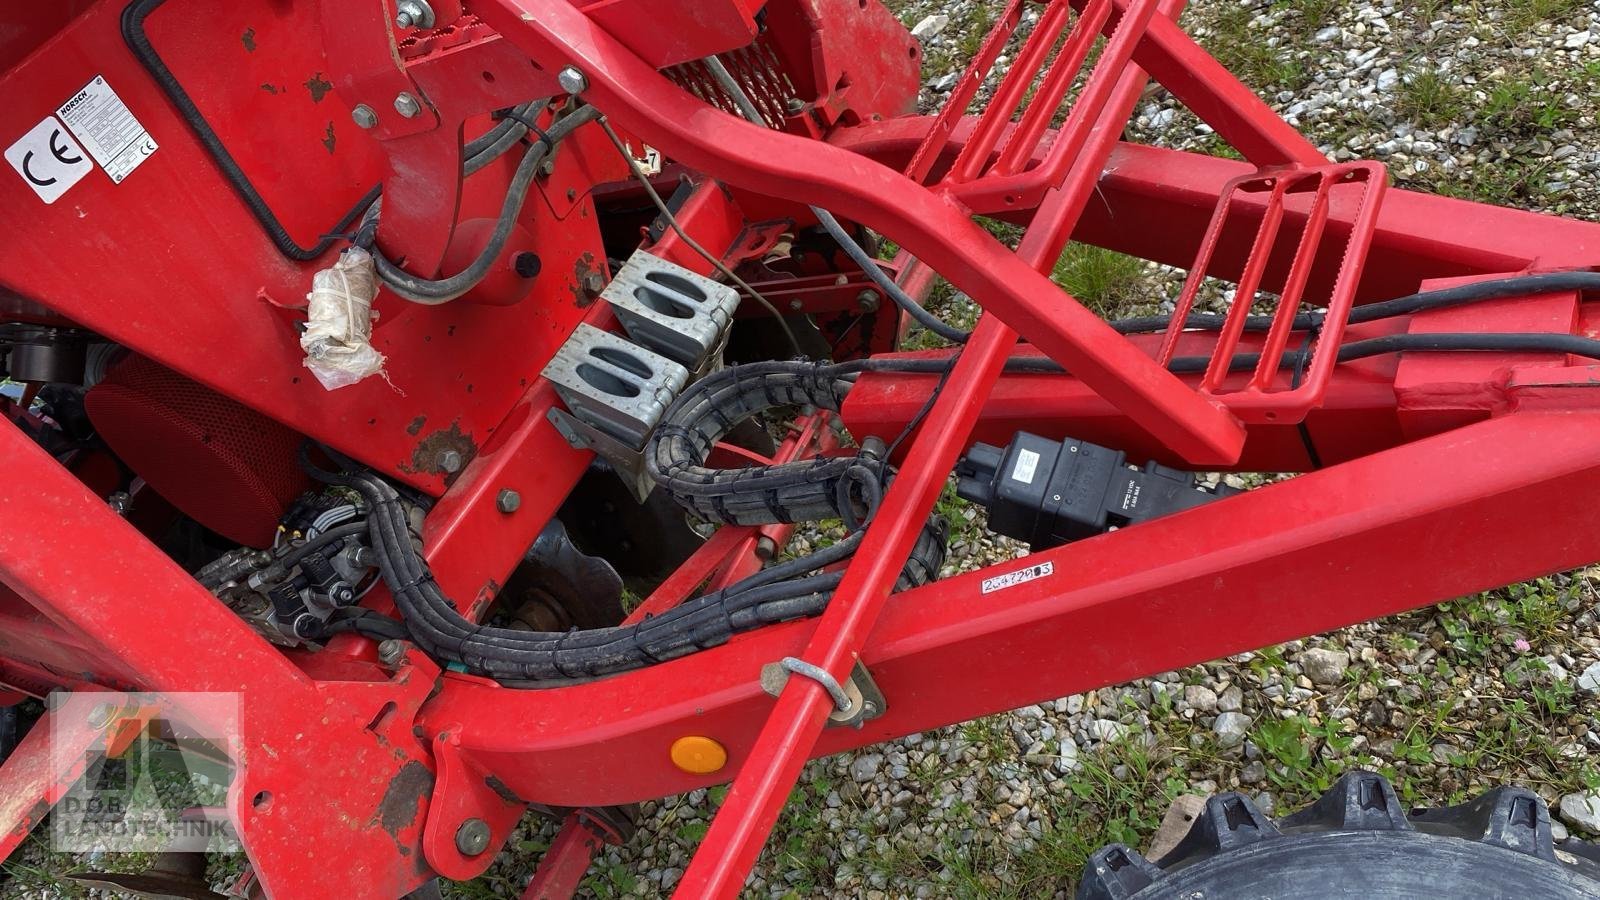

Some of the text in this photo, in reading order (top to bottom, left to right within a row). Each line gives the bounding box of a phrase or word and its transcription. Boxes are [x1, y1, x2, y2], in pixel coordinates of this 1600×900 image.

[61, 91, 88, 116] HORSCH
[23, 129, 83, 186] CE
[140, 140, 155, 156] CE
